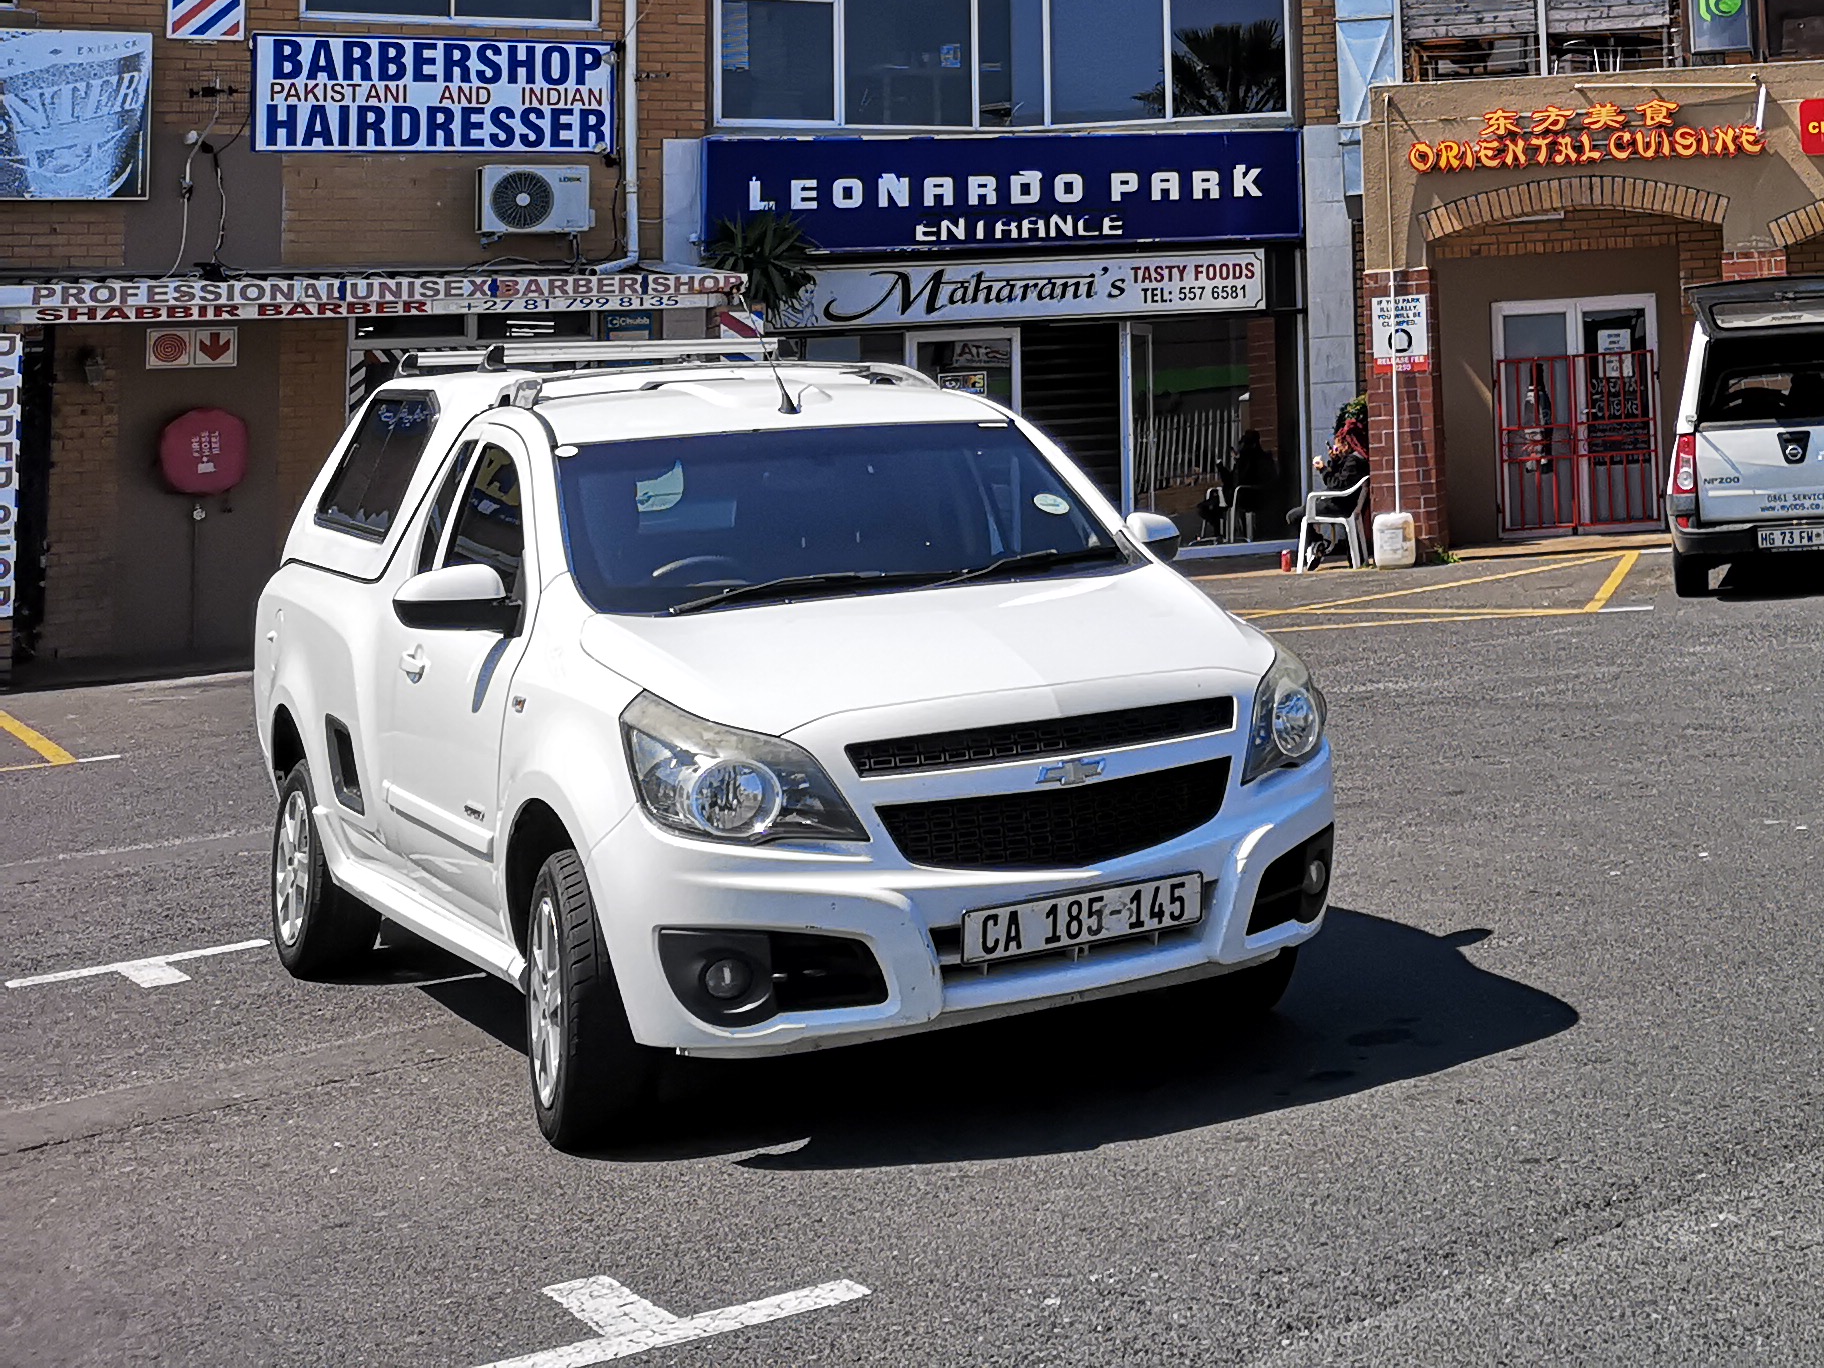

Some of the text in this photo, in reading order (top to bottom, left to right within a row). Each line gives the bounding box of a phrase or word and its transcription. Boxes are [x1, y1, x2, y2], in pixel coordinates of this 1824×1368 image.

[272, 38, 602, 86] BARBERSHOP
[270, 82, 603, 108] PAKISTANI AND INDIAN
[265, 104, 606, 149] HAIRDRESSER
[1480, 99, 1680, 138] 东方美食
[1408, 124, 1768, 173] ORIENTAL CUISINE
[749, 164, 1263, 211] LEONARDO PARK
[915, 214, 1123, 242] ENTRANCE
[1131, 261, 1256, 284] TASTY FOODS
[31, 273, 744, 306] PROFESSIONAL UNISEX BARBER SHOP
[823, 266, 1126, 322] Maharani's
[1142, 284, 1247, 303] TEL: 557 6581
[35, 300, 429, 322] SHABBIR BARBER
[461, 295, 680, 313] +27 81 799 8135
[619, 316, 649, 325] Chubb
[1703, 475, 1740, 485] NP200
[1767, 494, 1788, 503] 0861
[1780, 531, 1794, 545] 73
[981, 882, 1186, 955] CA 185-145
